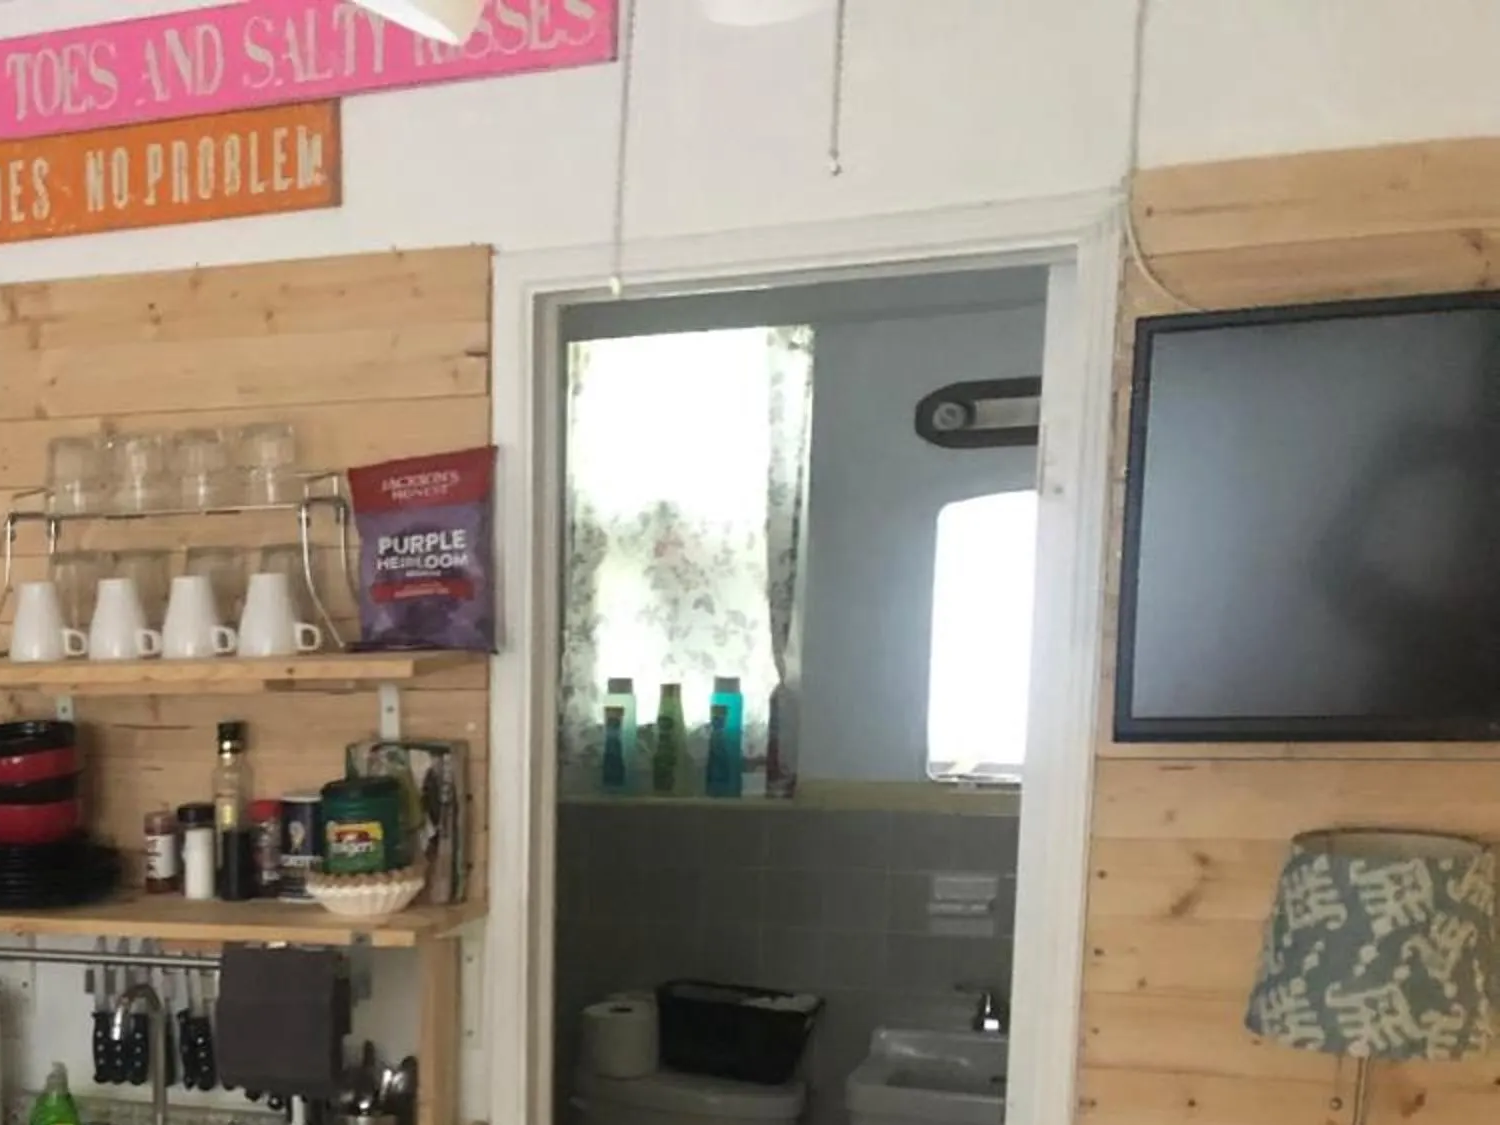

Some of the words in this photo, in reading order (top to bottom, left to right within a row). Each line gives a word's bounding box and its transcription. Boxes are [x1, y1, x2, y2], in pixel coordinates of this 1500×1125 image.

[5, 40, 118, 121] TOES
[135, 24, 224, 106] AND
[243, 2, 387, 88] SALTY
[414, 0, 596, 67] SSES
[85, 147, 130, 212] NO
[376, 553, 468, 570] HEIRLOOM
[378, 529, 467, 555] PURPLE
